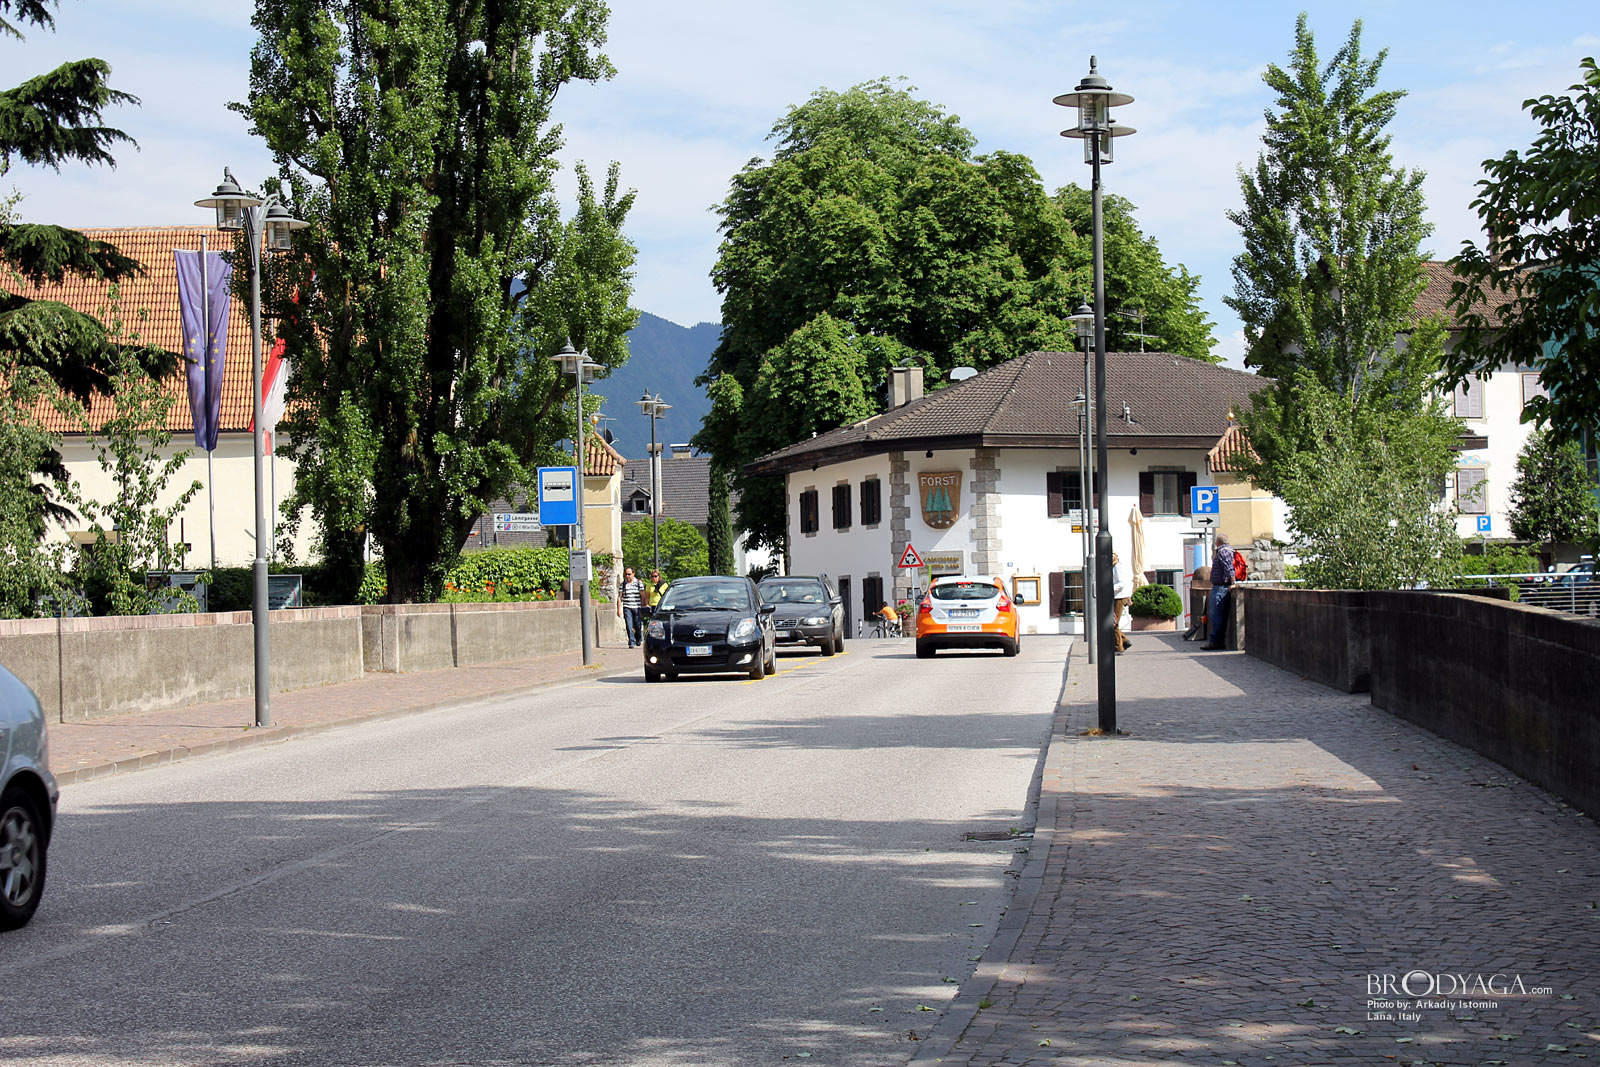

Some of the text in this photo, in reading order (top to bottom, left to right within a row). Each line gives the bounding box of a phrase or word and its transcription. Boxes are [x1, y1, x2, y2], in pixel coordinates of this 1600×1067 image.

[920, 475, 956, 487] FORST
[1197, 489, 1214, 511] P
[1479, 517, 1489, 530] P
